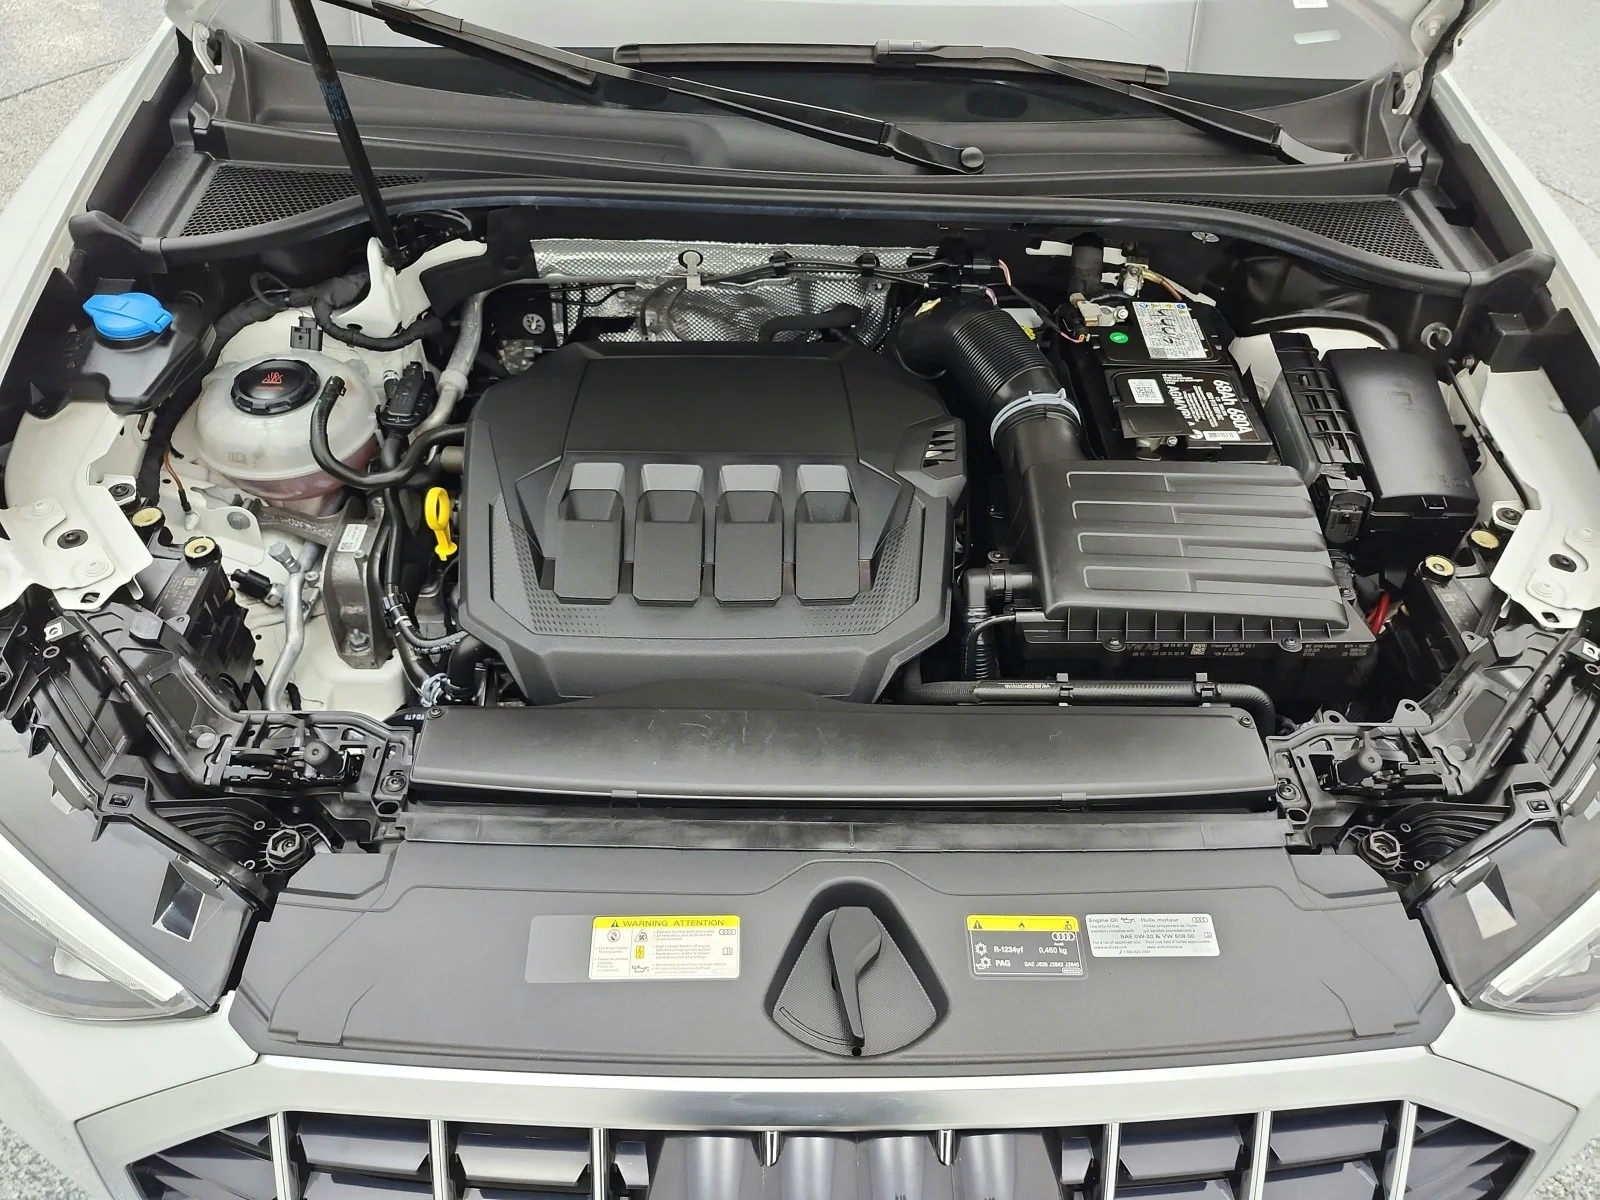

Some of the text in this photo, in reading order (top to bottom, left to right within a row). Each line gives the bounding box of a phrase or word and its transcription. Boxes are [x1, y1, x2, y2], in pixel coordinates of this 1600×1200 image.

[1213, 379, 1238, 406] 68Ah
[1227, 408, 1252, 434] 680A
[994, 946, 1023, 954] R-1234yf
[1058, 946, 1068, 955] kg
[996, 959, 1011, 967] PAG
